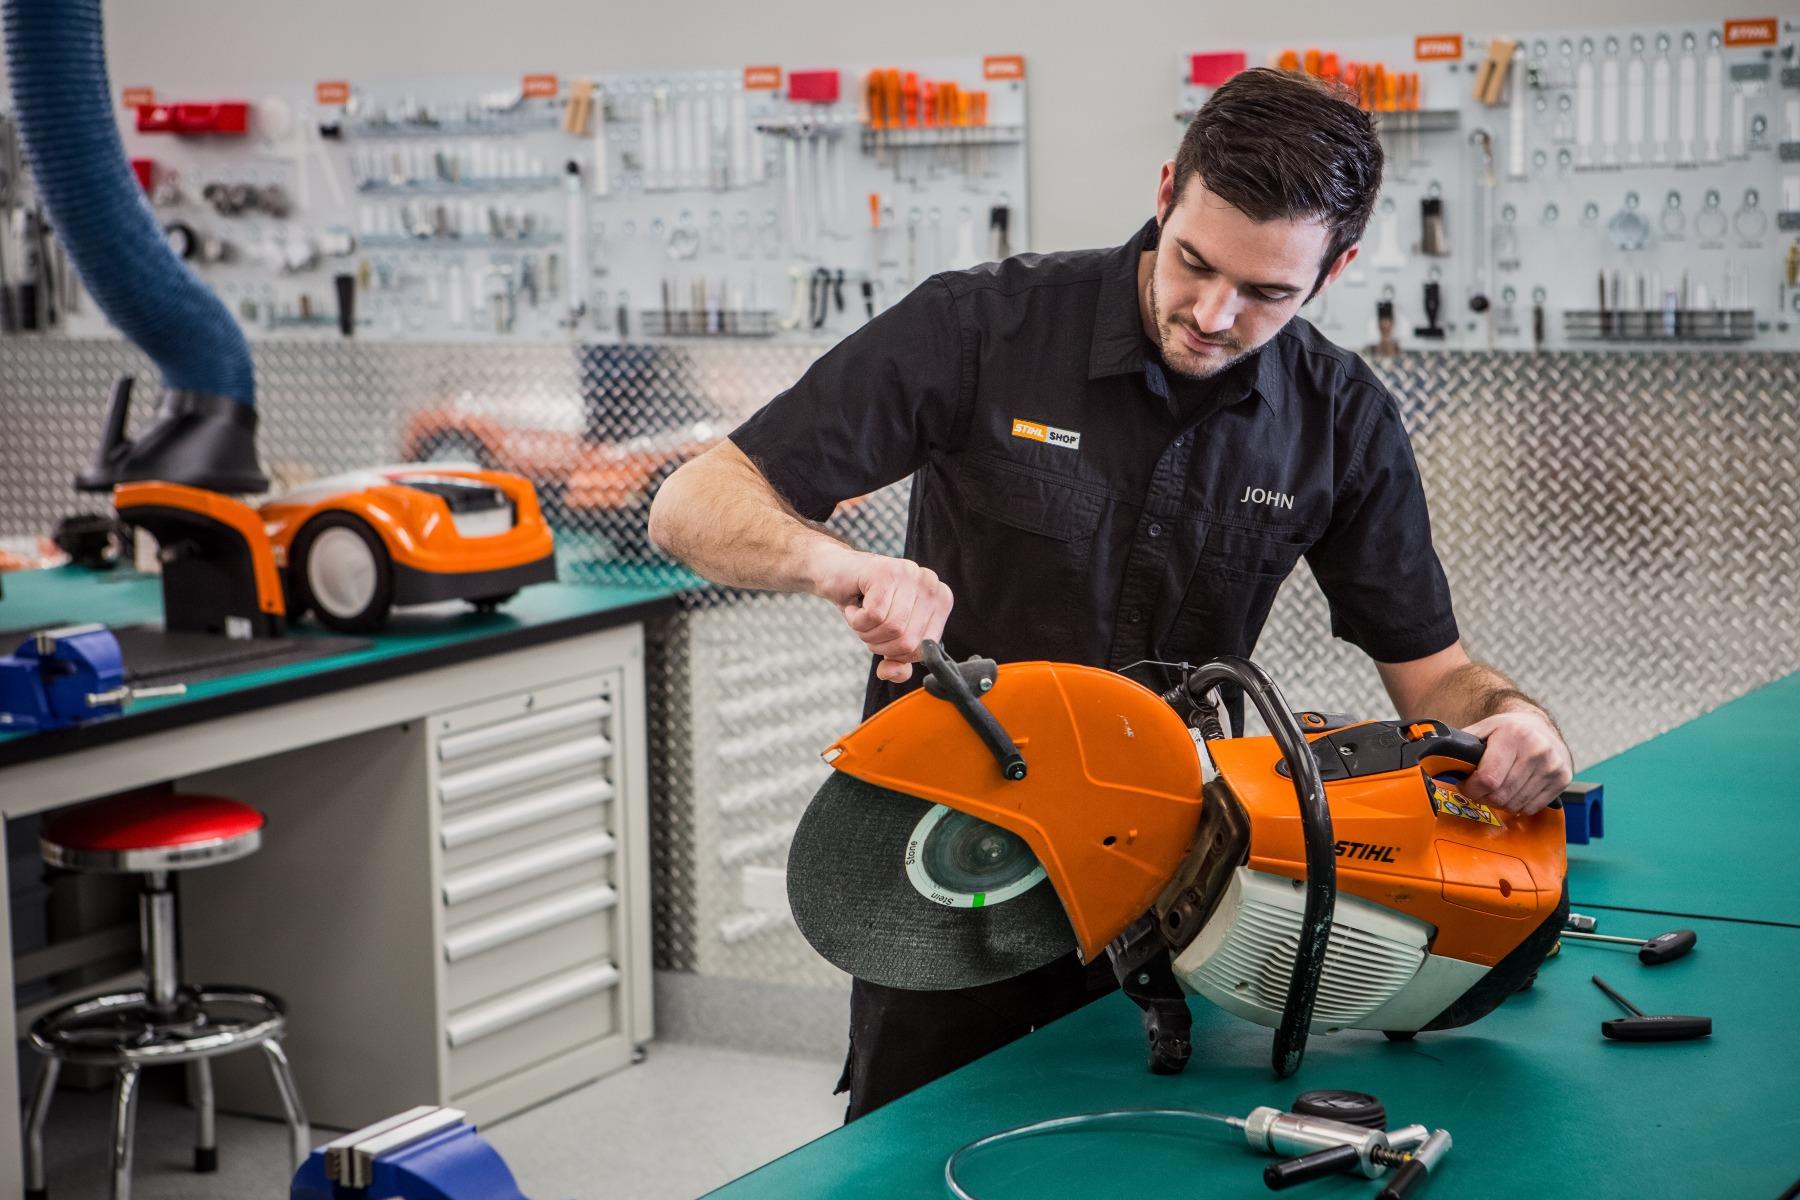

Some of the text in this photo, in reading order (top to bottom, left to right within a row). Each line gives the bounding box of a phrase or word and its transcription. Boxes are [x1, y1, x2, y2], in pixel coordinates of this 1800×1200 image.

[1014, 423, 1076, 444] STIHL SHOP
[1240, 486, 1295, 510] JOHN
[906, 840, 918, 866] Stone
[1334, 840, 1395, 863] STIHL
[930, 892, 954, 906] Stein
